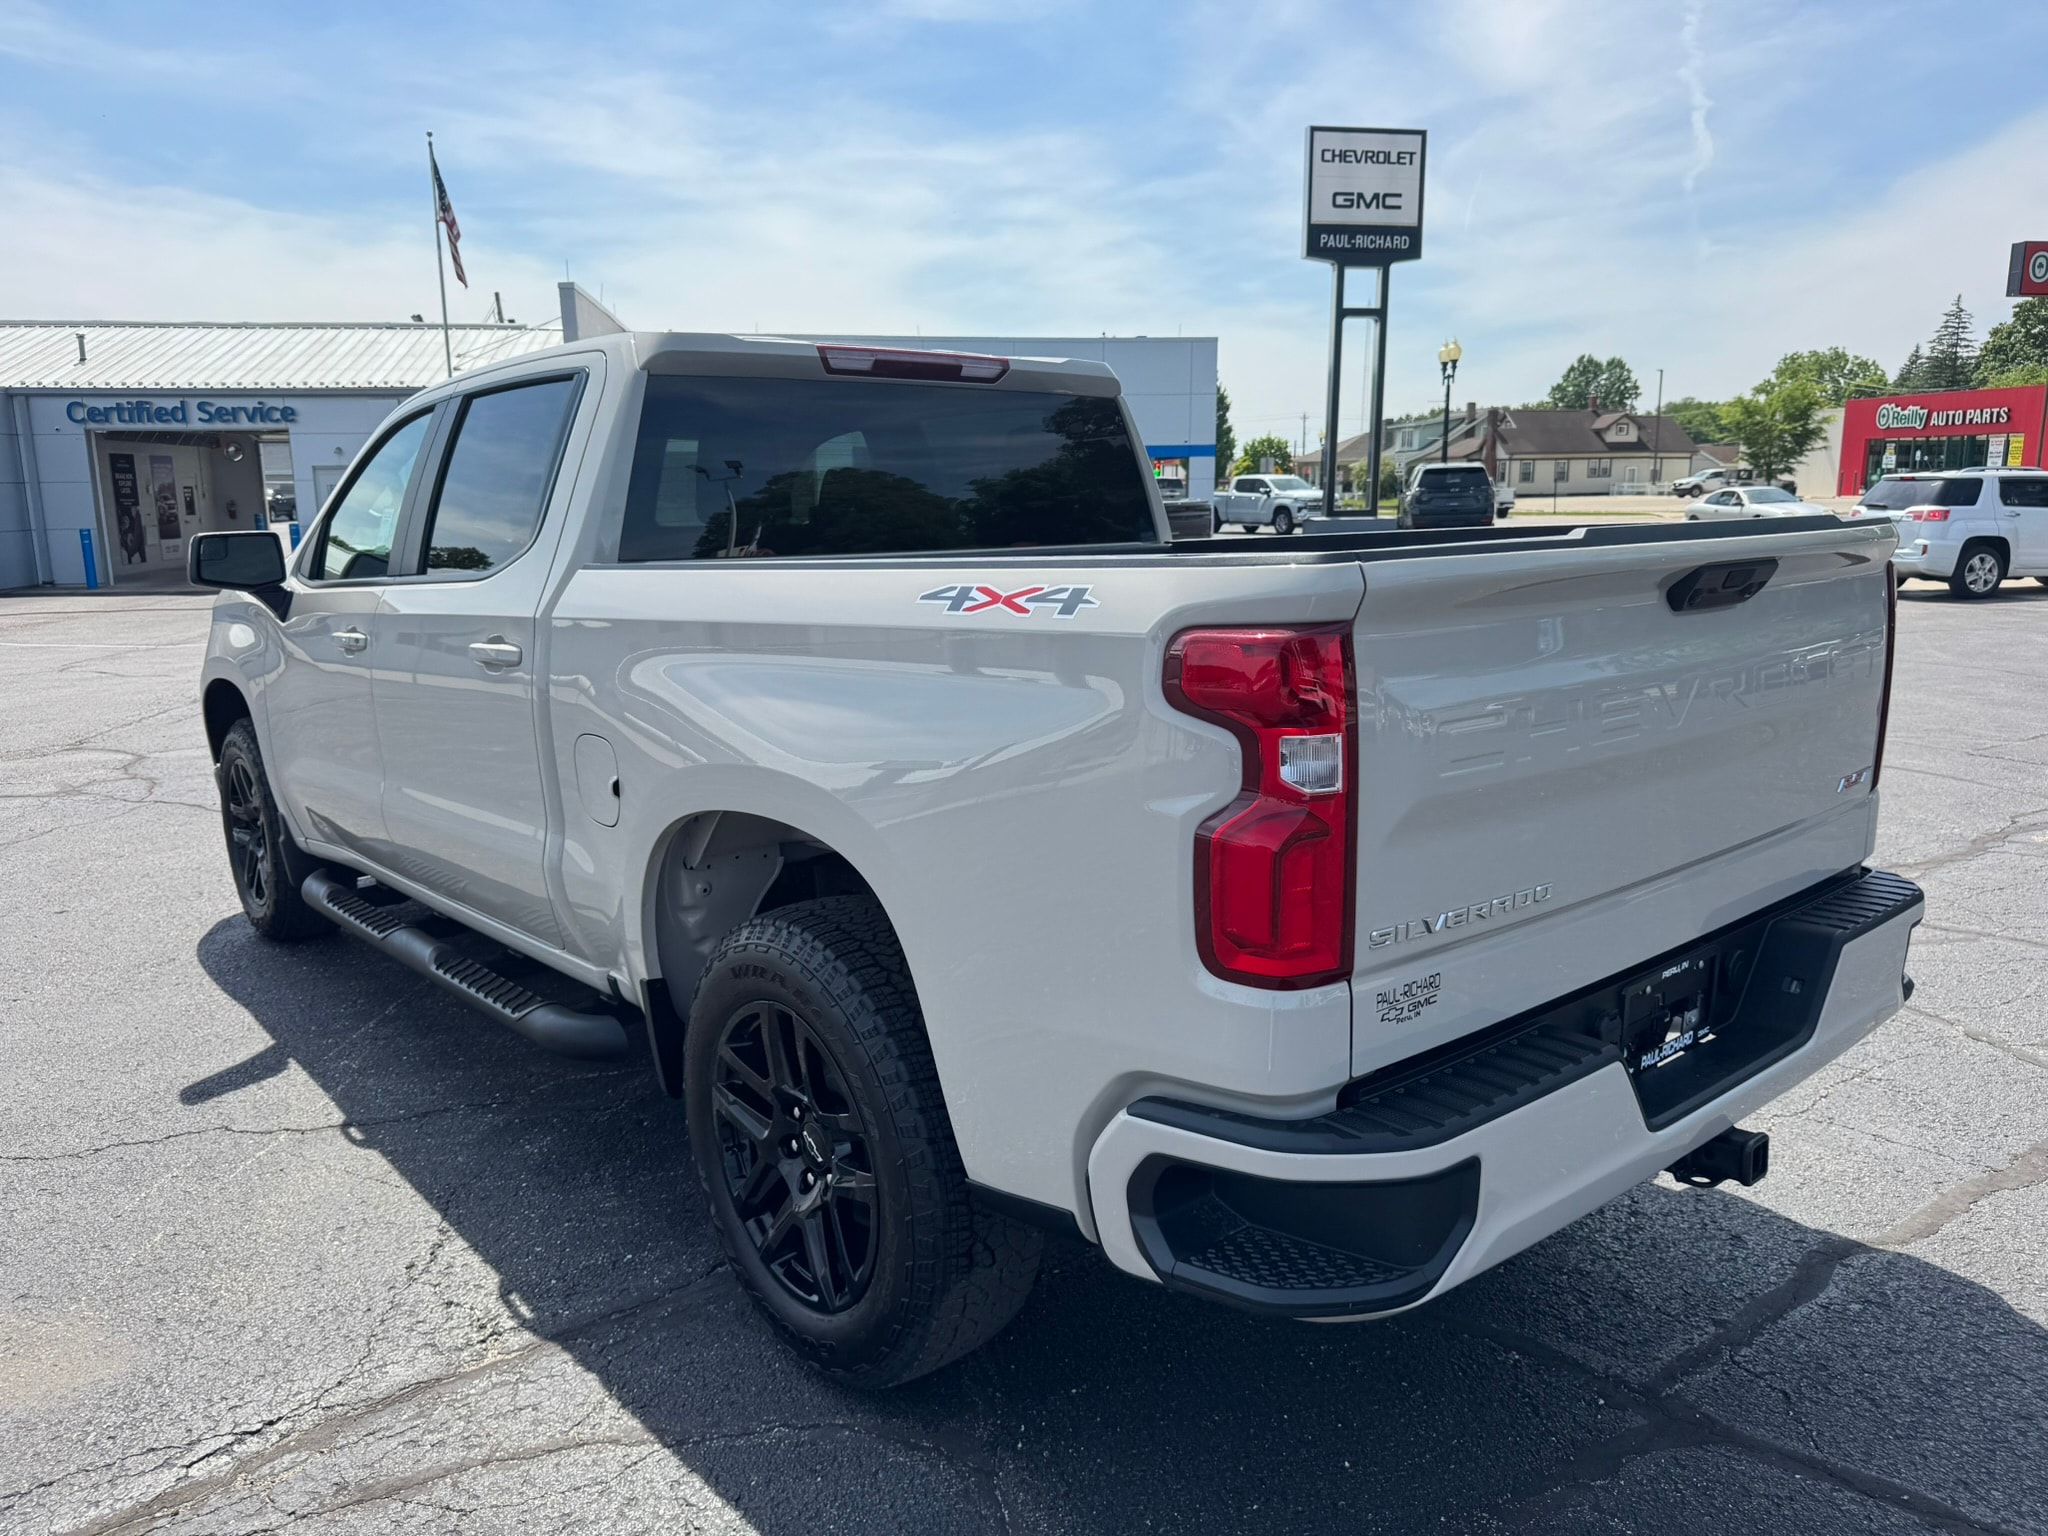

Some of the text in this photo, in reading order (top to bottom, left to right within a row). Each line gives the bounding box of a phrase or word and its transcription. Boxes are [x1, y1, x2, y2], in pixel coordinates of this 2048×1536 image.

[1321, 149, 1417, 165] CHEVROLET
[1332, 192, 1402, 210] GMC
[1320, 234, 1410, 249] PAUL-RICHARD
[66, 400, 297, 424] Certified Service
[1876, 403, 2009, 429] O'Reilly AUTO PARTS
[1369, 882, 1553, 950] SILVERADO
[1376, 972, 1441, 1008] PAUL-RICHARD
[1407, 994, 1438, 1013] GMC
[1640, 1030, 1694, 1070] PAUL-RICHARD
